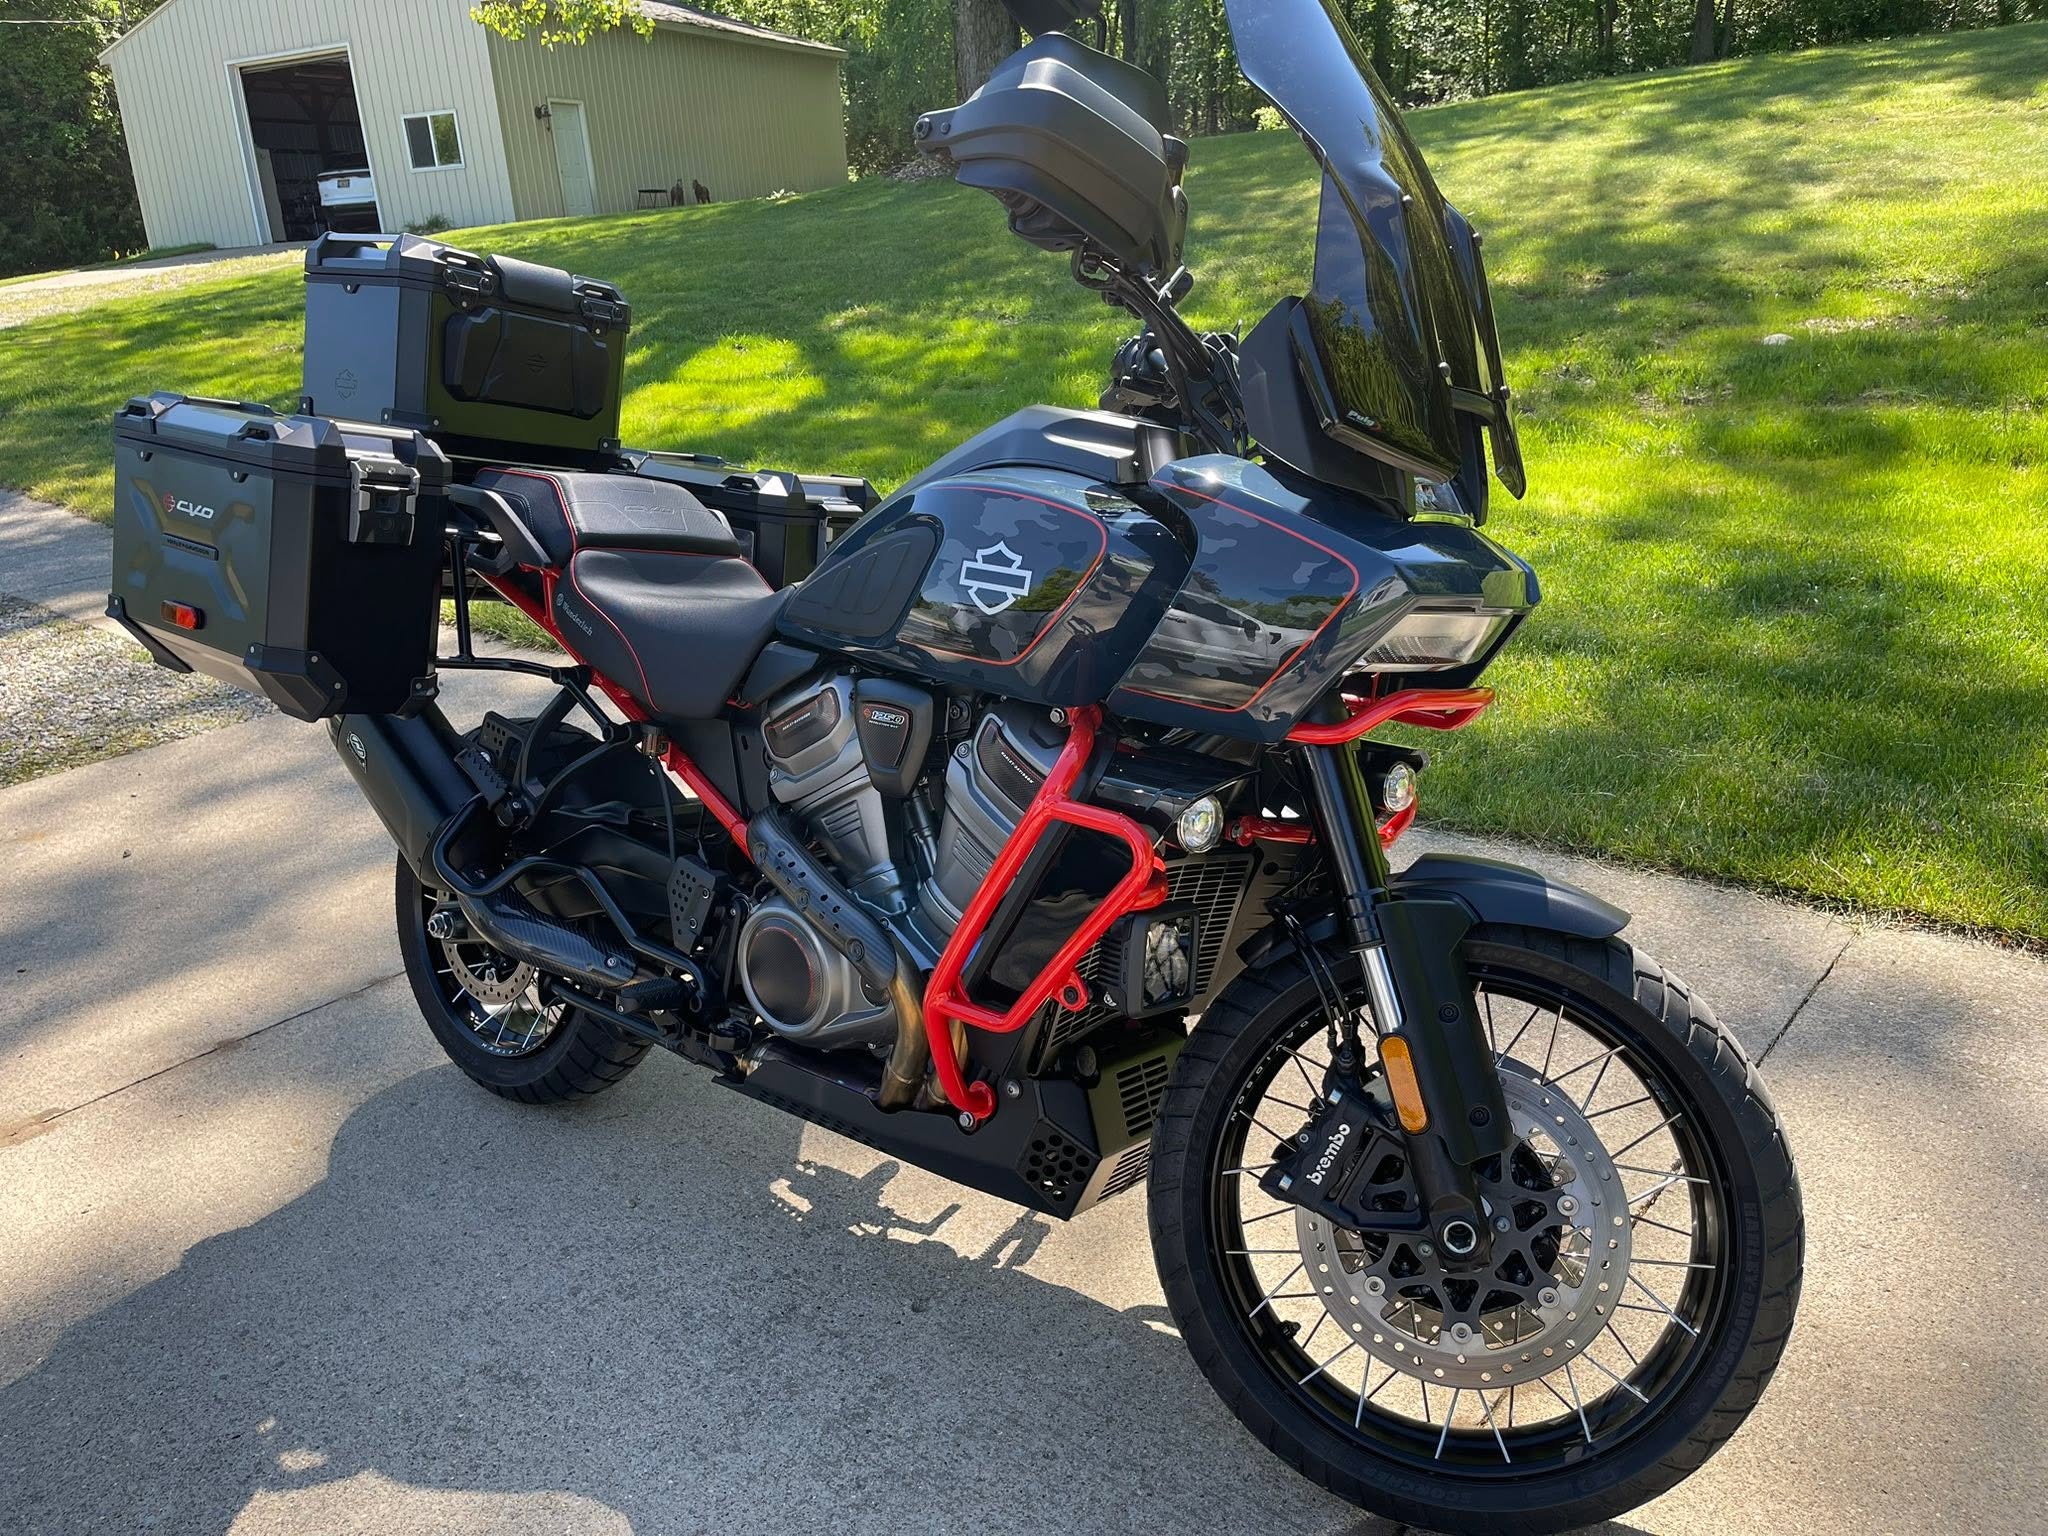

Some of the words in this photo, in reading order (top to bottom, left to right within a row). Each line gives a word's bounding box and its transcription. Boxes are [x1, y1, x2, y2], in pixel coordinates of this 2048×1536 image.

[176, 500, 214, 519] CVO
[871, 710, 905, 725] 1250
[1001, 751, 1034, 784] HARLEY-DAVIDSON
[1305, 1123, 1351, 1186] brembo
[1706, 1202, 1761, 1391] HARLEY-DAVIDSON
